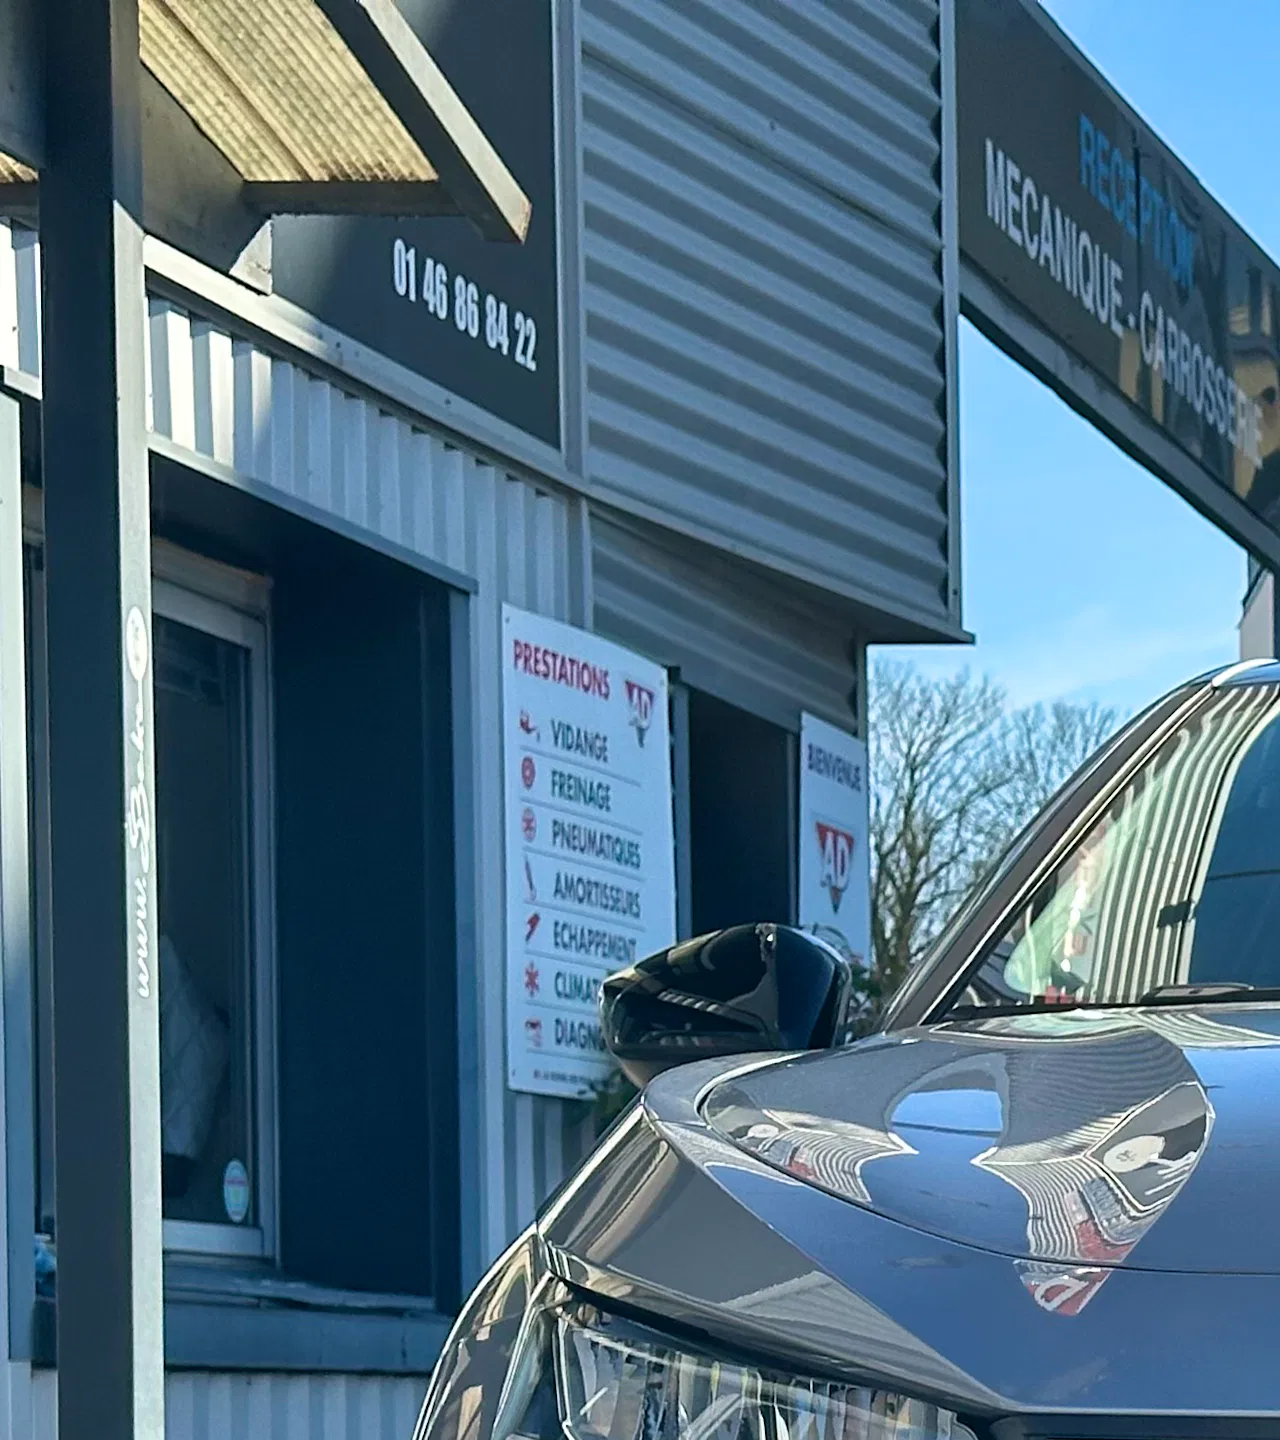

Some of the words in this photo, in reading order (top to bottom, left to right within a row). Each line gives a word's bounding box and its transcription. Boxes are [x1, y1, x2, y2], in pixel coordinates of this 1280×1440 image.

[1079, 112, 1196, 291] RECEPTION
[393, 238, 416, 302] 01
[422, 257, 448, 320] 46
[454, 274, 480, 338] 86
[485, 293, 509, 356] 84
[514, 311, 537, 372] 22
[985, 137, 1124, 339] MECANIQUE
[1140, 290, 1264, 471] CARROSSERIE
[513, 639, 610, 701] PRESTATIONS
[550, 718, 608, 764] VIDANGE
[551, 769, 611, 812] FREINAGE
[807, 742, 862, 794] BIENVENUE
[551, 819, 641, 870] PNEUMATIQUES
[553, 870, 641, 920] AMORTISSEURS
[553, 920, 637, 964] ECHAPPEMENT
